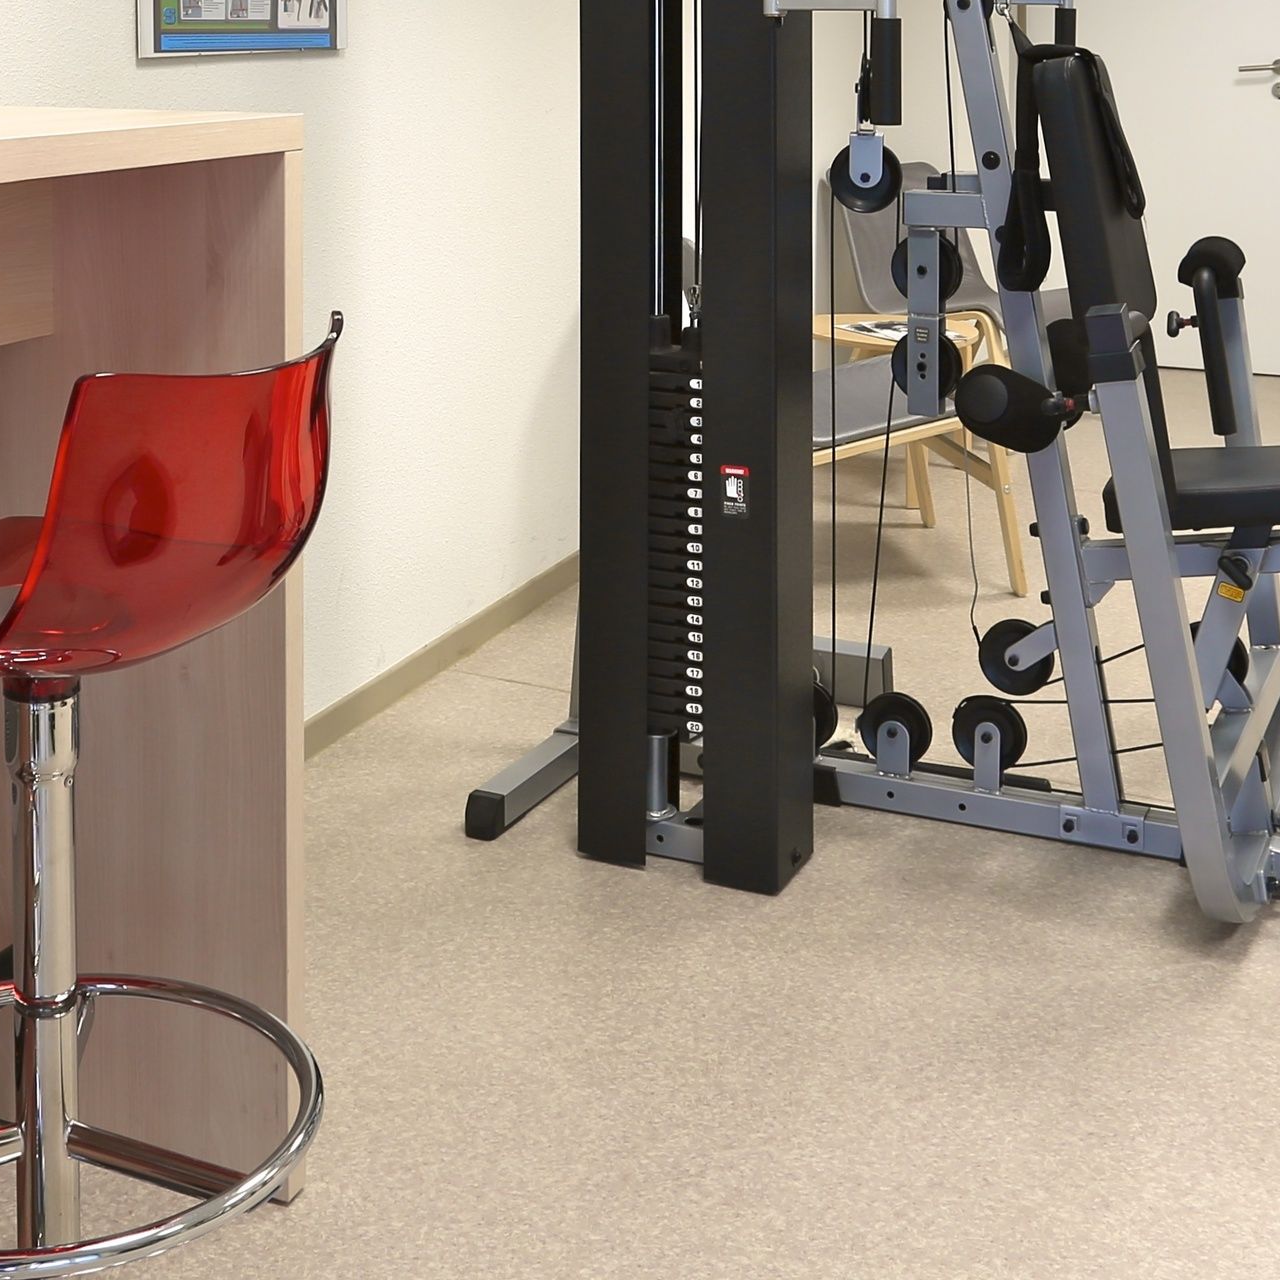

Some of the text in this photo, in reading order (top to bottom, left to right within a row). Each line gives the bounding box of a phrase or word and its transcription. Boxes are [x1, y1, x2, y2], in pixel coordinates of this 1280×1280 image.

[690, 544, 700, 552] 10
[690, 562, 700, 570] 11
[690, 579, 700, 588] 12
[690, 597, 701, 606] 13
[690, 616, 700, 624] 14
[692, 634, 702, 642] 15
[691, 652, 701, 660] 16
[690, 669, 700, 678] 17
[689, 687, 699, 695] 18
[689, 705, 699, 713] 19
[689, 723, 700, 731] 20
